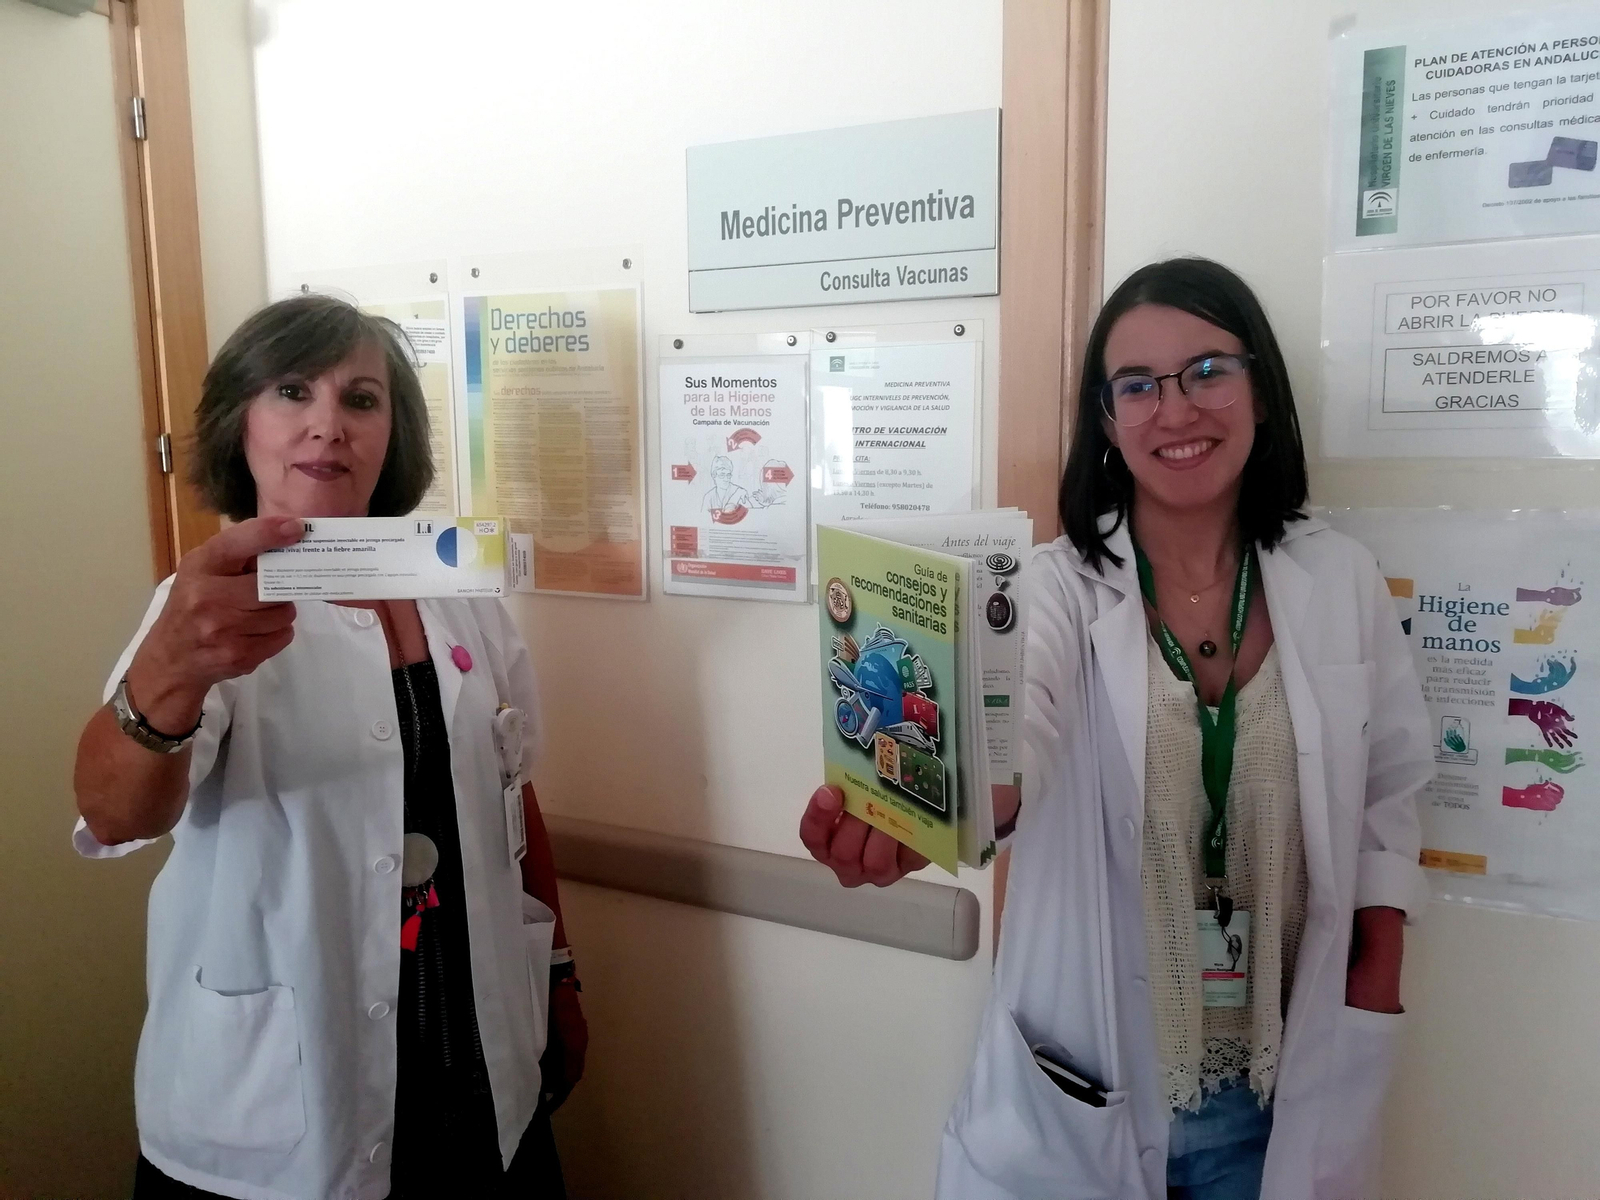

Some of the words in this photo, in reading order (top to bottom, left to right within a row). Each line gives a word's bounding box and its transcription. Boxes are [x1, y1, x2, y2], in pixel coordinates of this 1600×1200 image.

[1414, 55, 1447, 68] PLAN
[1451, 52, 1468, 64] DE
[1470, 42, 1536, 61] ATENCIÓN
[1539, 42, 1549, 52] A
[1552, 36, 1600, 50] PERSO
[1425, 60, 1510, 80] CUIDADORAS
[1513, 58, 1531, 69] EN
[1534, 50, 1600, 66] ANDALUC
[1385, 79, 1396, 115] NIEVES
[1412, 92, 1431, 102] Las
[1434, 86, 1486, 101] personas
[1488, 82, 1510, 95] que
[1513, 78, 1553, 90] tengan
[1556, 75, 1566, 84] la
[1430, 107, 1476, 120] Cuidado
[1487, 100, 1530, 114] tendrán
[1542, 92, 1594, 108] prioridad
[1384, 117, 1394, 135] LAS
[1410, 128, 1456, 142] atención
[1460, 128, 1474, 137] en
[1478, 125, 1495, 134] las
[1500, 120, 1554, 132] consultas
[1559, 114, 1600, 126] médica
[1383, 137, 1393, 149] DE
[1408, 152, 1422, 162] de
[1425, 147, 1487, 160] enfermería.
[1382, 152, 1392, 188] VIRGEN
[720, 203, 828, 241] Medicina
[837, 188, 975, 230] Preventiva
[820, 268, 890, 292] Consulta
[896, 264, 968, 286] Vacunas
[1411, 294, 1450, 310] POR
[1456, 290, 1521, 307] FAVOR
[1527, 288, 1557, 303] NO
[490, 306, 586, 330] Derechos
[1398, 314, 1454, 330] ABRIR
[490, 338, 500, 355] y
[505, 330, 590, 353] deberes
[1412, 350, 1530, 367] SALDREMOS
[685, 376, 708, 388] Sus
[712, 376, 778, 388] Momentos
[1422, 370, 1536, 386] ATENDERLE
[684, 392, 710, 405] para
[714, 391, 724, 402] la
[728, 390, 775, 405] Higiene
[1435, 394, 1520, 410] GRACIAS
[690, 405, 705, 416] de
[709, 405, 726, 416] las
[730, 405, 772, 417] Manos
[888, 426, 948, 434] VACUNACIÓN
[728, 439, 738, 450] 2
[855, 440, 926, 448] INTERNACIONAL
[673, 467, 678, 478] 1
[765, 469, 772, 480] 4
[860, 502, 890, 510] Teléfono:
[713, 510, 721, 520] 3
[942, 536, 970, 548] Antes
[974, 534, 989, 546] del
[993, 537, 1016, 550] viaje
[914, 564, 934, 579] Guía
[936, 571, 948, 582] de
[886, 571, 937, 596] consejos
[940, 587, 948, 603] y
[1458, 582, 1471, 592] La
[850, 575, 947, 618] recomendaciones
[1418, 595, 1510, 618] Higiene
[892, 605, 947, 635] sanitarias
[1448, 615, 1477, 632] de
[1422, 636, 1501, 653] manos
[1454, 657, 1493, 666] medida
[1456, 666, 1486, 676] eficaz
[904, 681, 915, 689] PASS
[1426, 675, 1449, 684] para
[1453, 676, 1492, 686] reducir
[844, 772, 869, 792] Nuestra
[870, 787, 888, 802] salud
